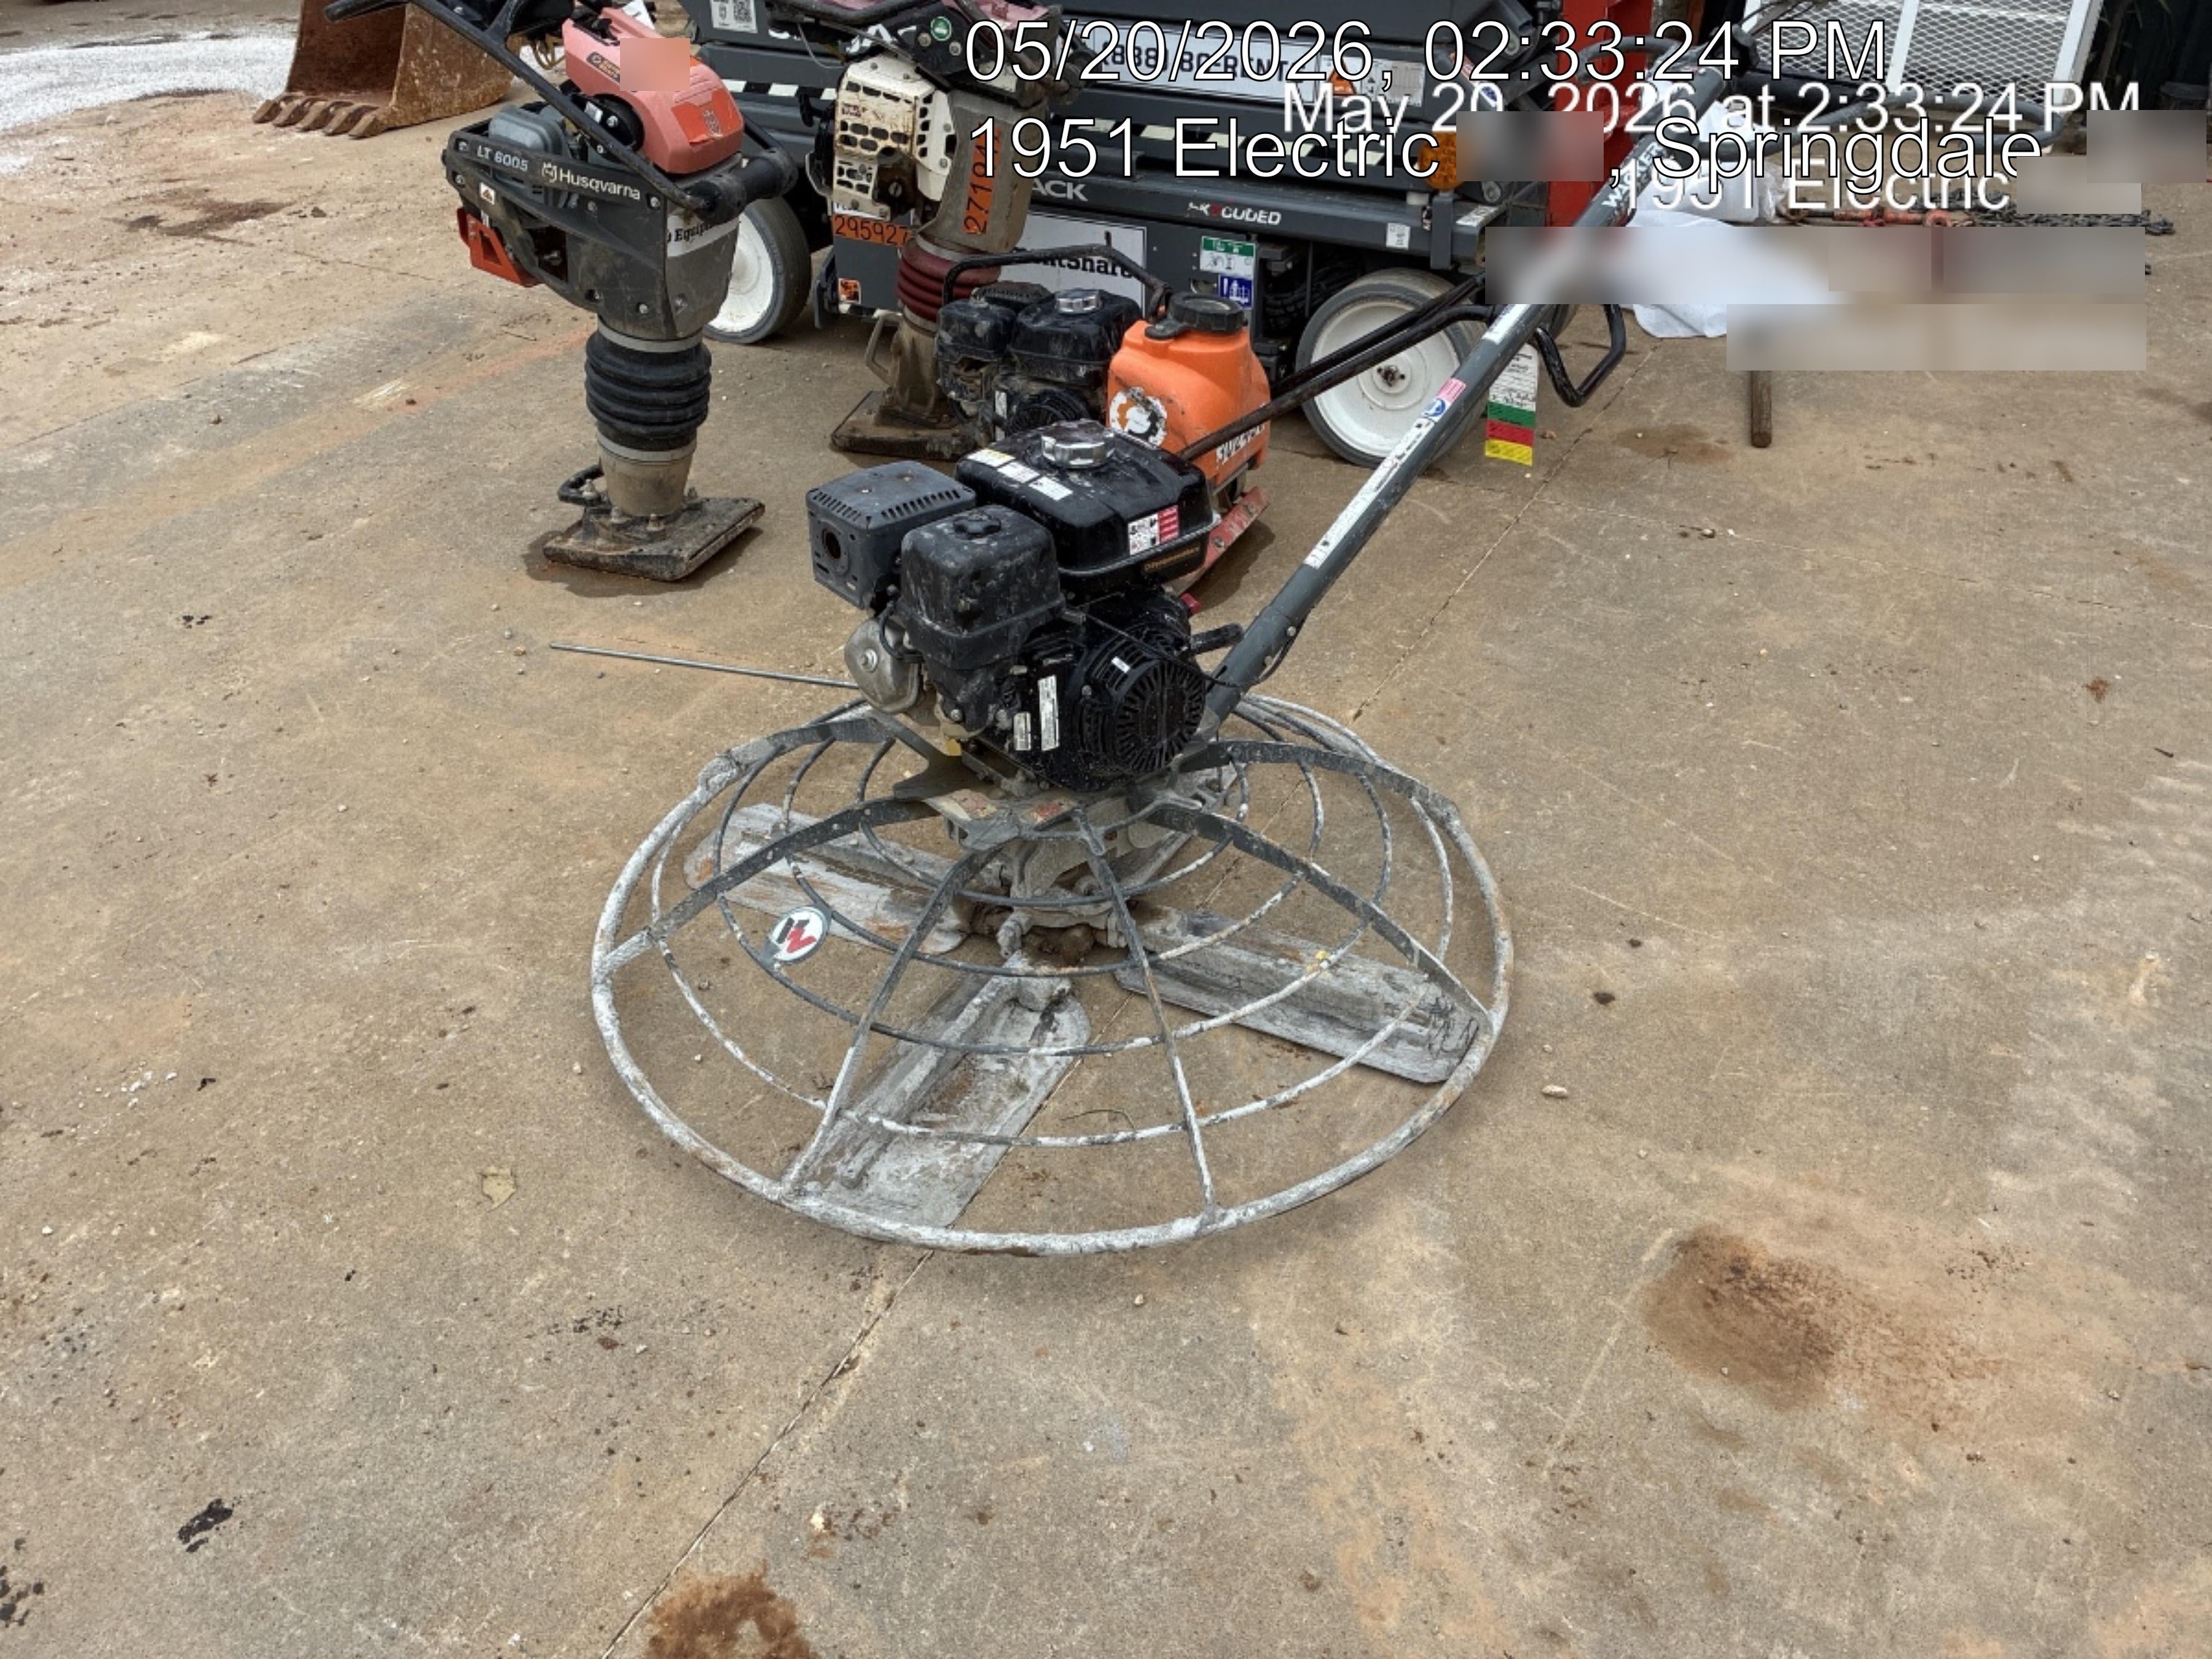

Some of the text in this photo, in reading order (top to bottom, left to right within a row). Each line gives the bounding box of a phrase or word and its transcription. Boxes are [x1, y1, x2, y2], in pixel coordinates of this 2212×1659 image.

[477, 145, 528, 171] LT 6005
[560, 167, 640, 200] Husqvarna
[834, 216, 908, 245] 295927
